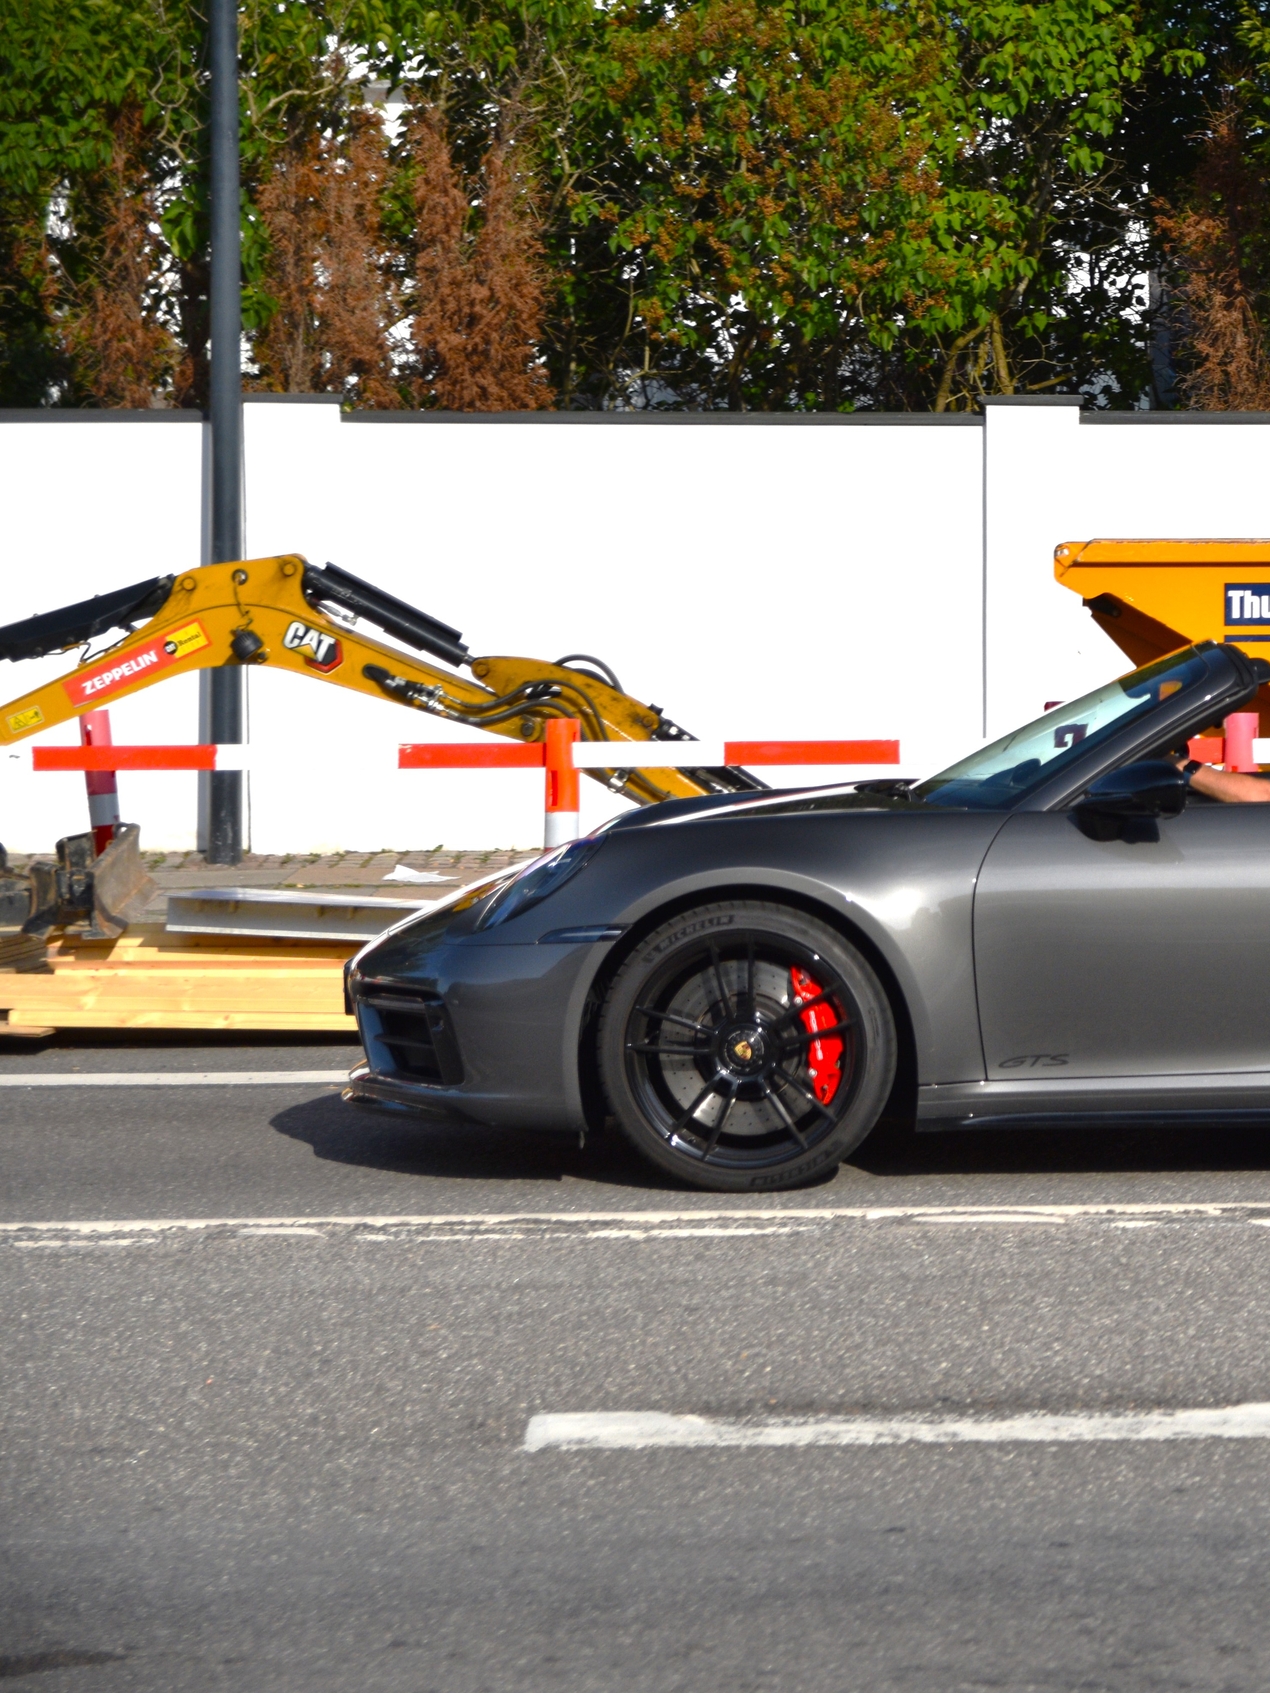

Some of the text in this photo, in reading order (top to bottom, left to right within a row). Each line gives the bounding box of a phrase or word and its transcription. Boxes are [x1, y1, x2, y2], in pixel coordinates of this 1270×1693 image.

[283, 621, 336, 662] CAT
[81, 649, 159, 696] ZEPPELIN
[998, 1053, 1070, 1069] GTS
